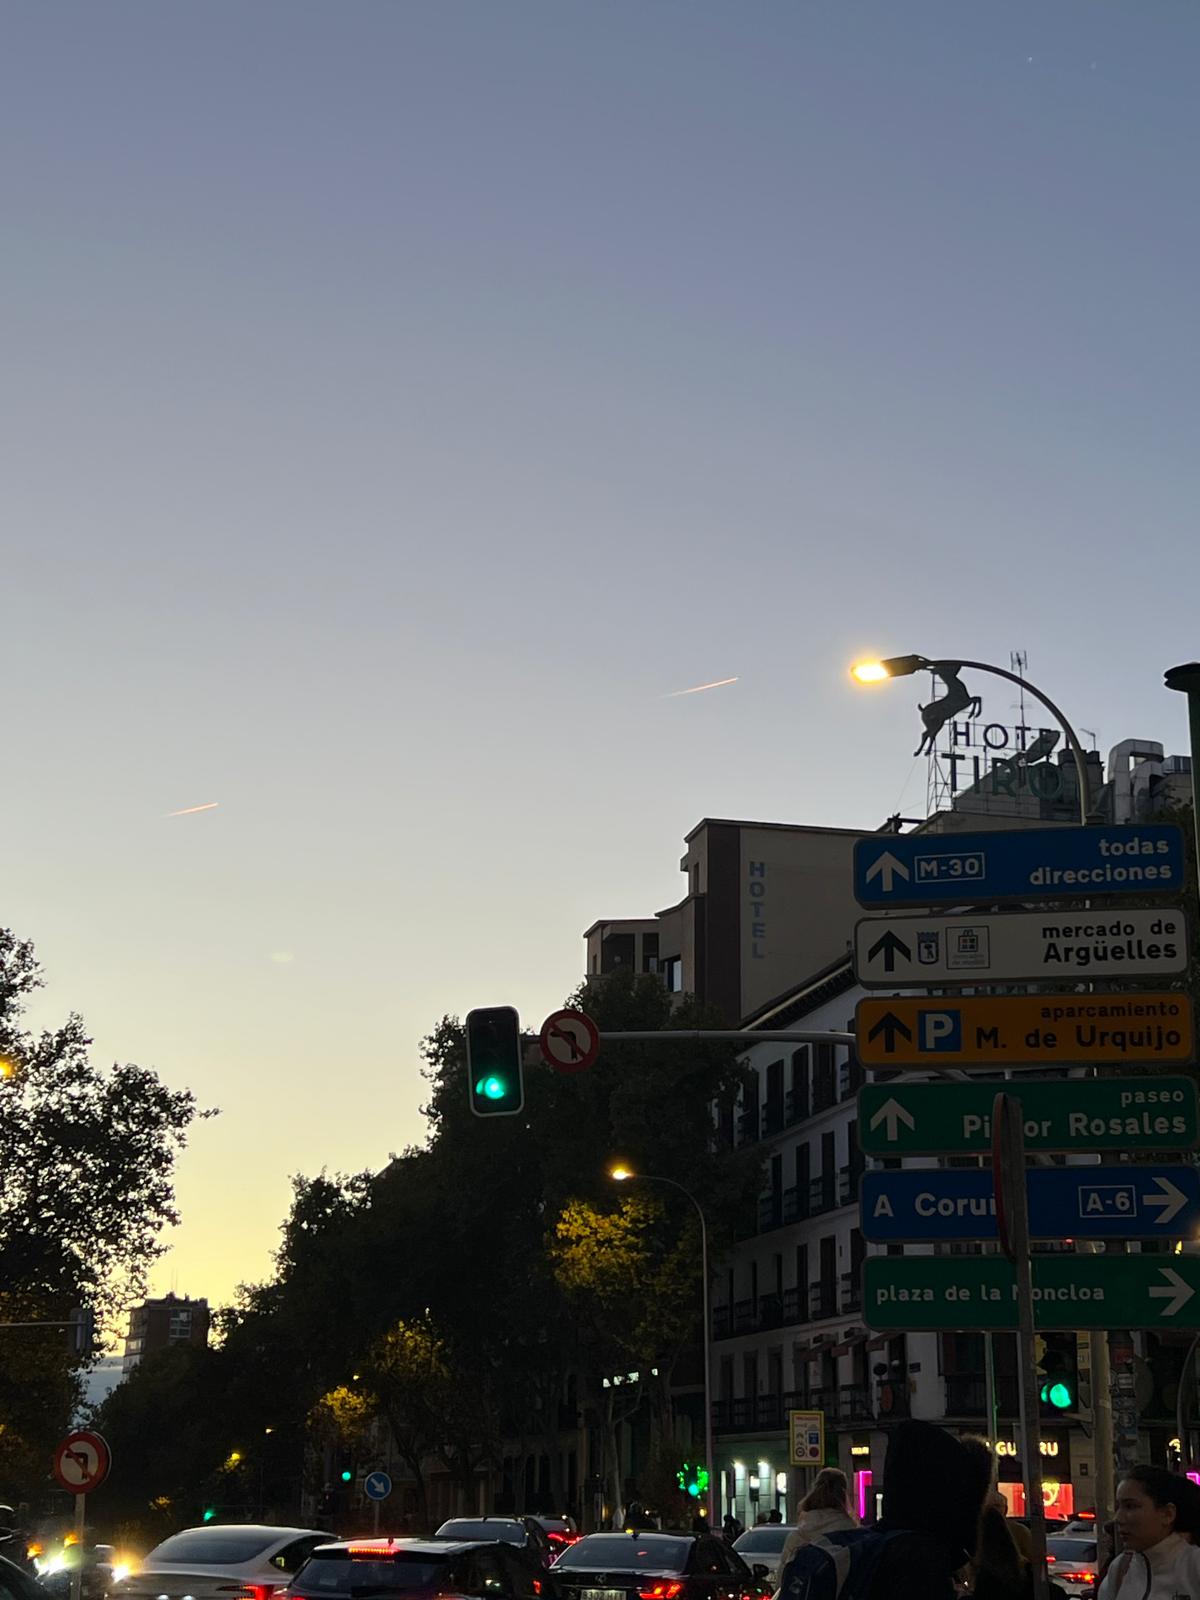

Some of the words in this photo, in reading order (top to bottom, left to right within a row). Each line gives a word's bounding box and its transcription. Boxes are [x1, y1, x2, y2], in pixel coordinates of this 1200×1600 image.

[1098, 837, 1169, 857] todas
[919, 857, 981, 877] M-30
[1029, 864, 1172, 885] direcciones
[749, 861, 766, 959] HOTEL
[1042, 920, 1135, 938] mercado
[1150, 919, 1176, 935] de
[1043, 940, 1177, 966] Argüelles
[1040, 1002, 1180, 1021] aparcamiento
[924, 1013, 954, 1049] P
[975, 1027, 1007, 1049] M.
[1024, 1028, 1057, 1049] de
[1075, 1024, 1181, 1053] Urquijo
[1121, 1090, 1184, 1107] paseo
[963, 1114, 1052, 1138] Pior
[1068, 1112, 1187, 1136] Rosales
[873, 1194, 894, 1217] A
[914, 1192, 997, 1217] Coru
[1086, 1192, 1130, 1212] A-6
[876, 1285, 934, 1305] plaza
[944, 1286, 971, 1301] de
[980, 1284, 1001, 1301] la
